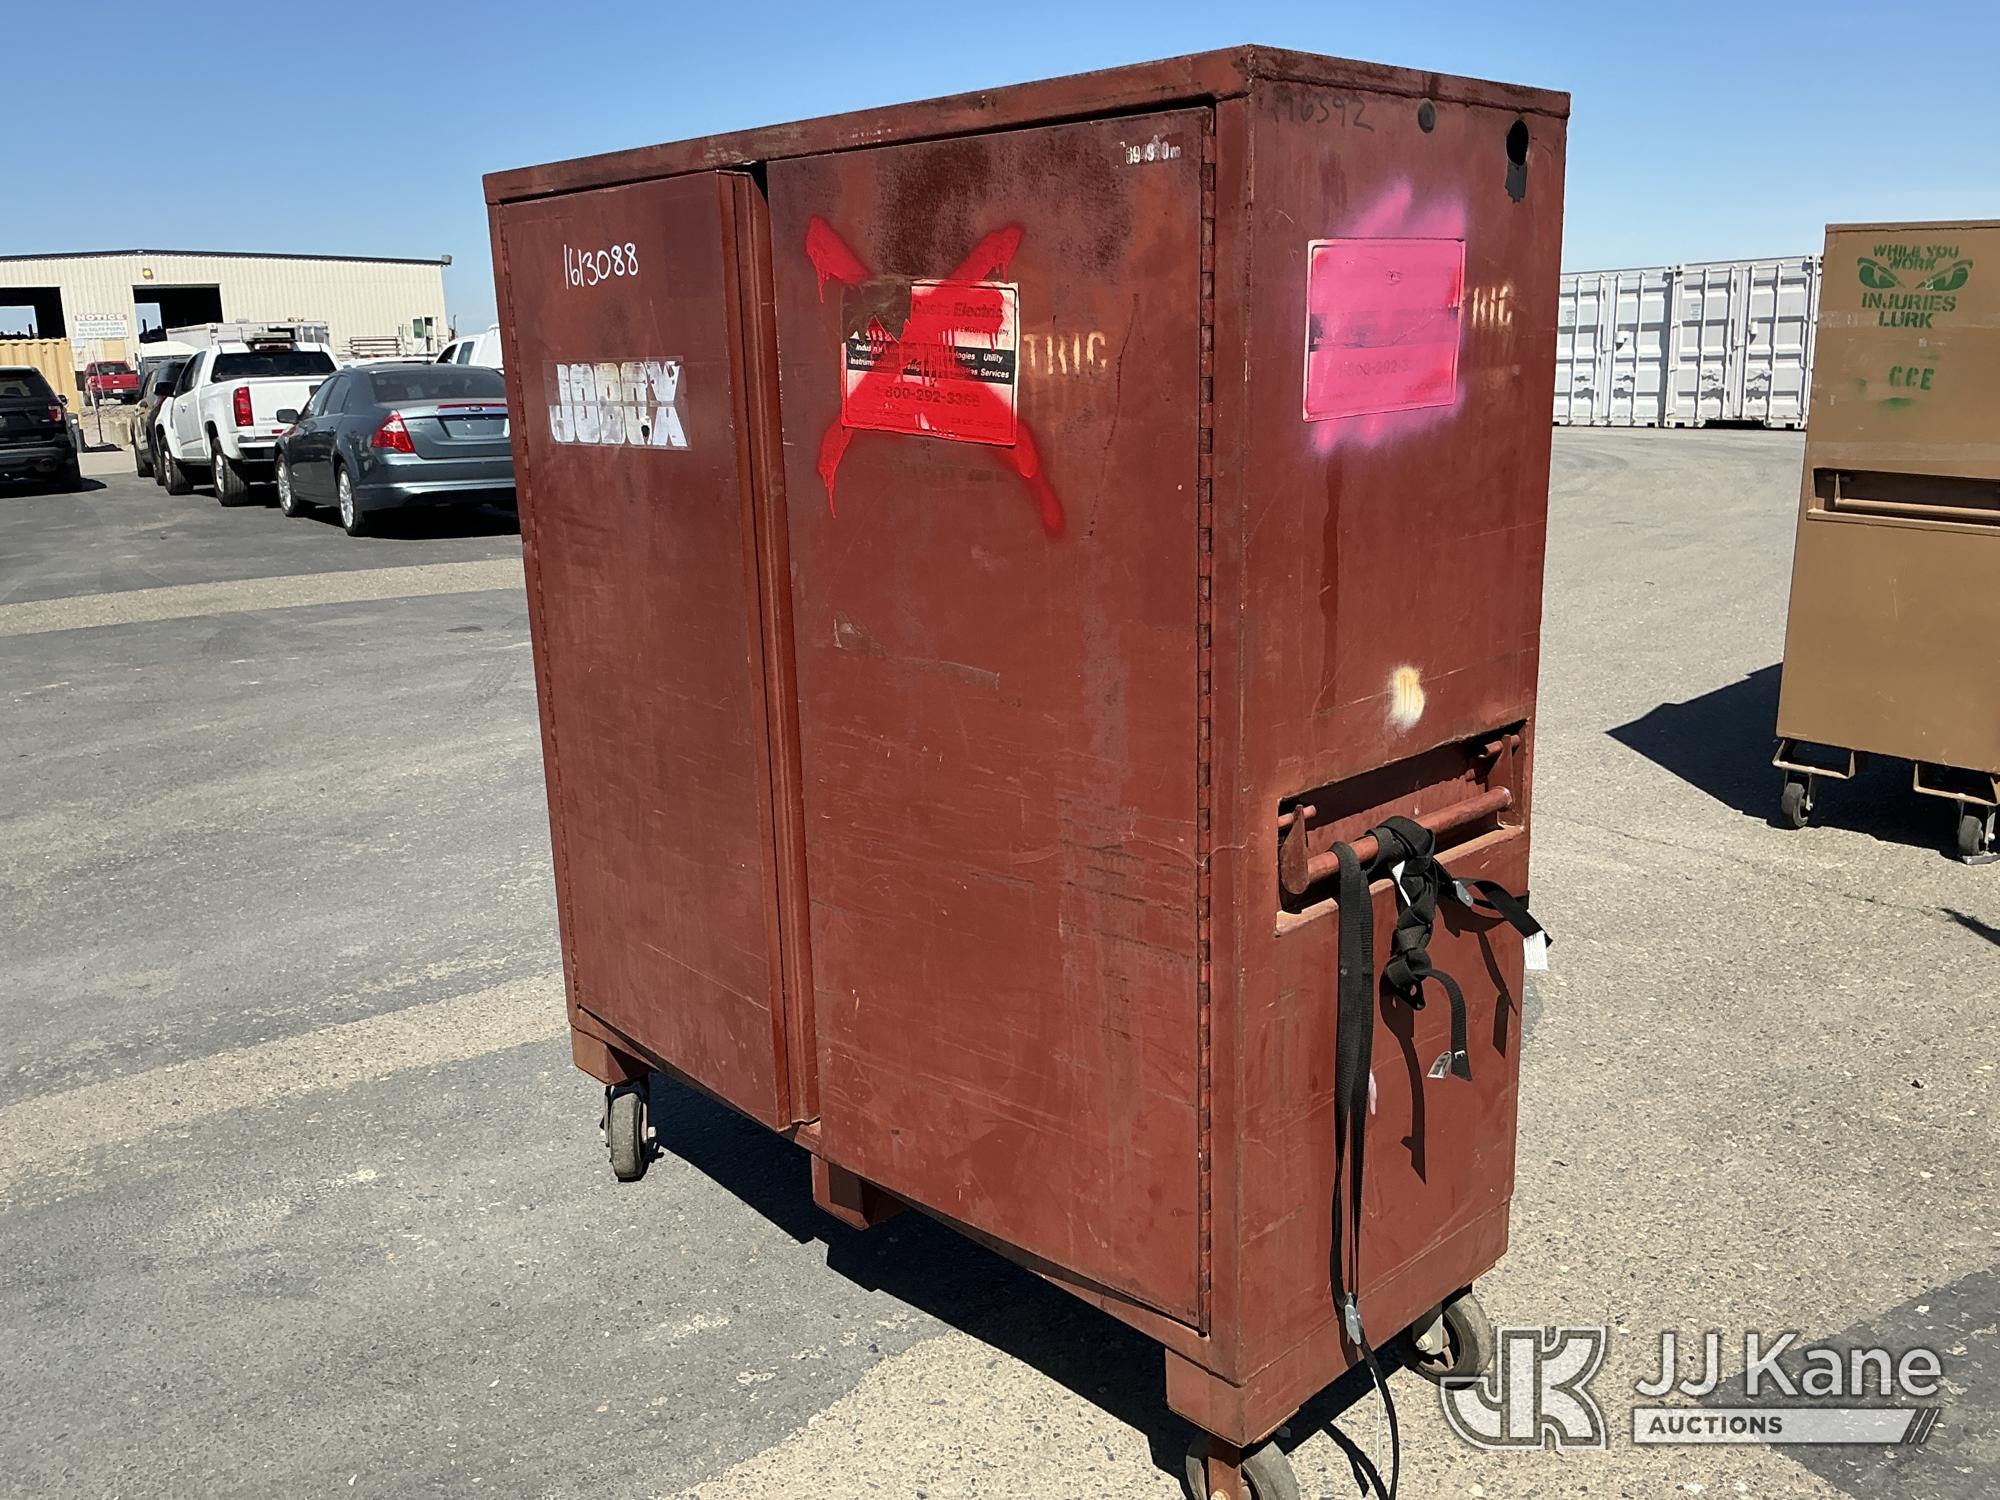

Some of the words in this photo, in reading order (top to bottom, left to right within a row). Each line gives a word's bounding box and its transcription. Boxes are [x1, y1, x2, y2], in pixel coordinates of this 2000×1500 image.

[1873, 245, 1920, 258] WHILE
[1926, 245, 1960, 259] YOU
[563, 242, 639, 290] 1613088
[1889, 256, 1937, 271] WORK
[1861, 292, 1957, 312] INJURIES
[76, 313, 125, 321] NOTICE
[1878, 311, 1934, 329] LURK
[983, 353, 1004, 364] Utility
[980, 368, 1010, 379] Services
